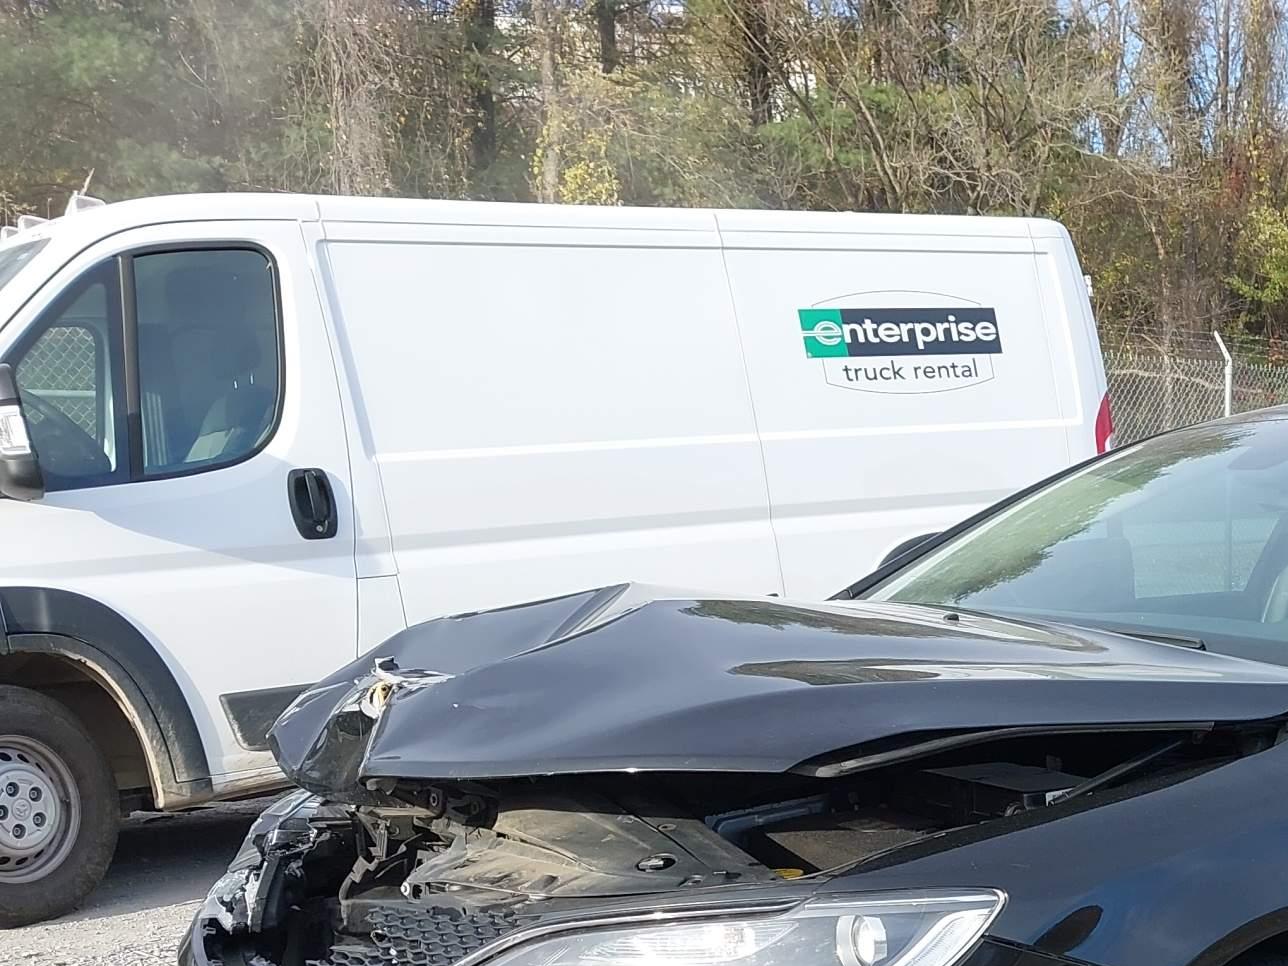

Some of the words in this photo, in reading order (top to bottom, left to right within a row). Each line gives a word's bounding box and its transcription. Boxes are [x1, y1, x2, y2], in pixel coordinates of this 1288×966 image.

[803, 316, 997, 350] enterprise
[842, 359, 906, 382] truck
[912, 357, 979, 380] rental
